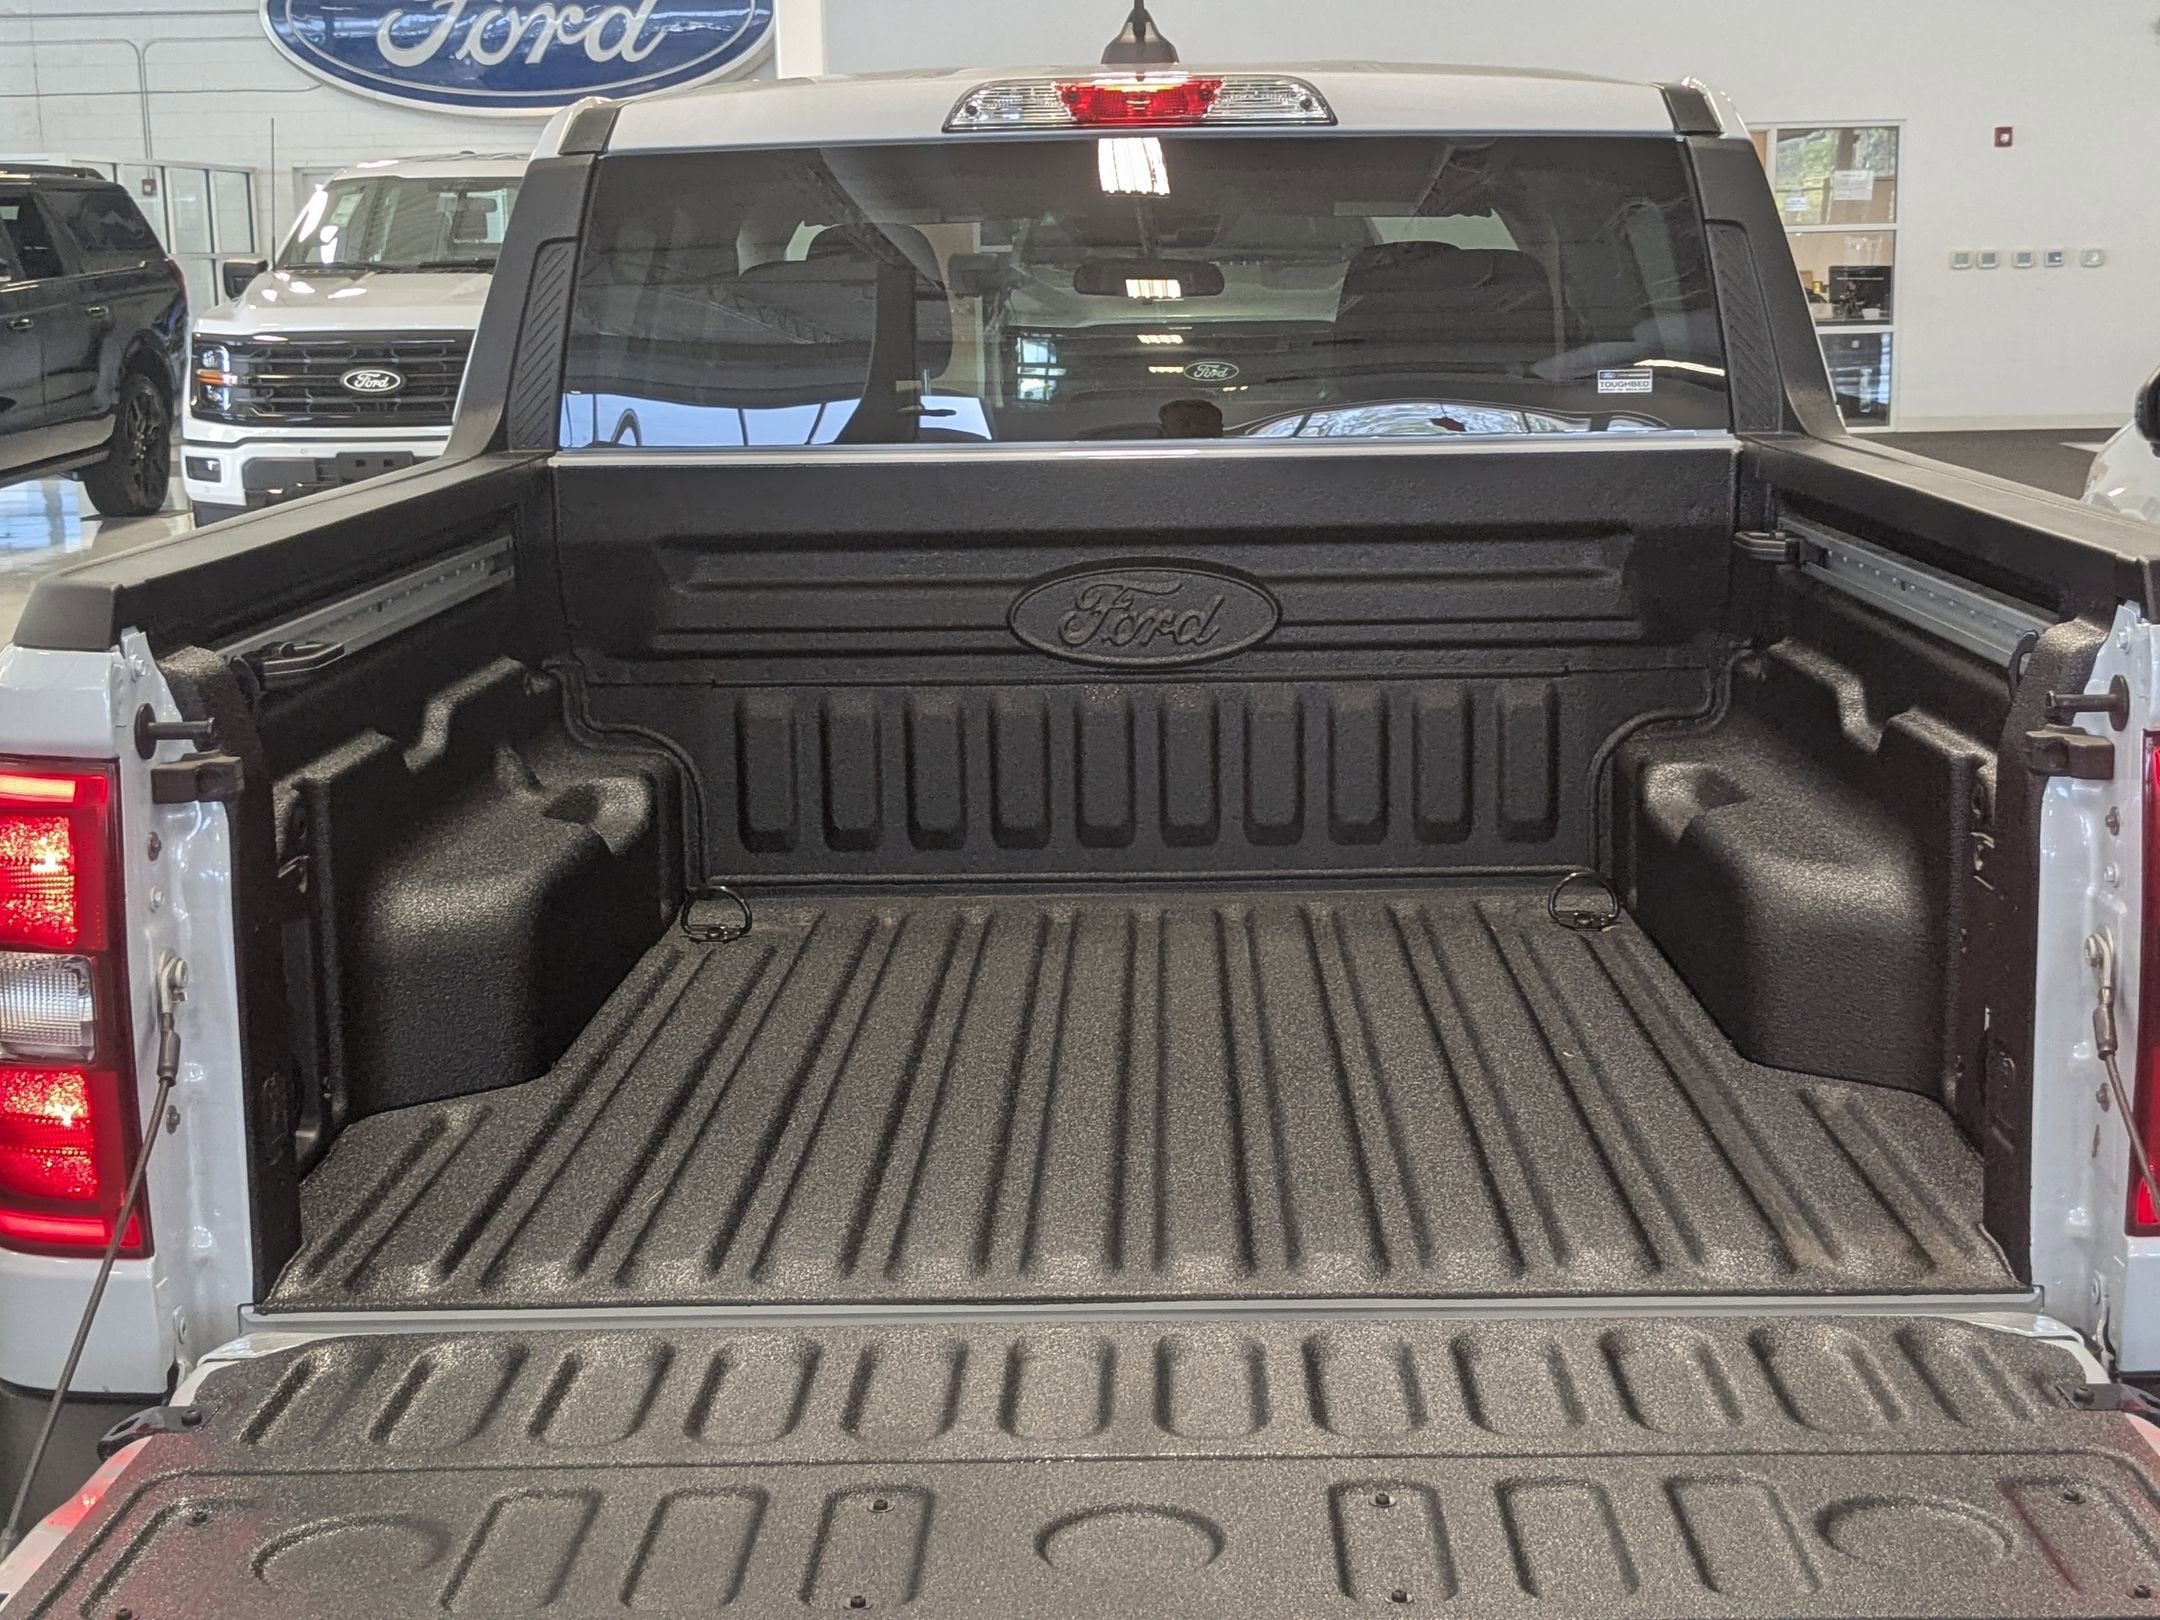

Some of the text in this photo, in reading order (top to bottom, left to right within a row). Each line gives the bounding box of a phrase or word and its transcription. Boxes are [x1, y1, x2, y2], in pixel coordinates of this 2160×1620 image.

[1194, 364, 1228, 378] Ford
[354, 373, 389, 388] Ford
[1600, 380, 1649, 388] TOUGHBED
[1058, 578, 1225, 649] Ford
